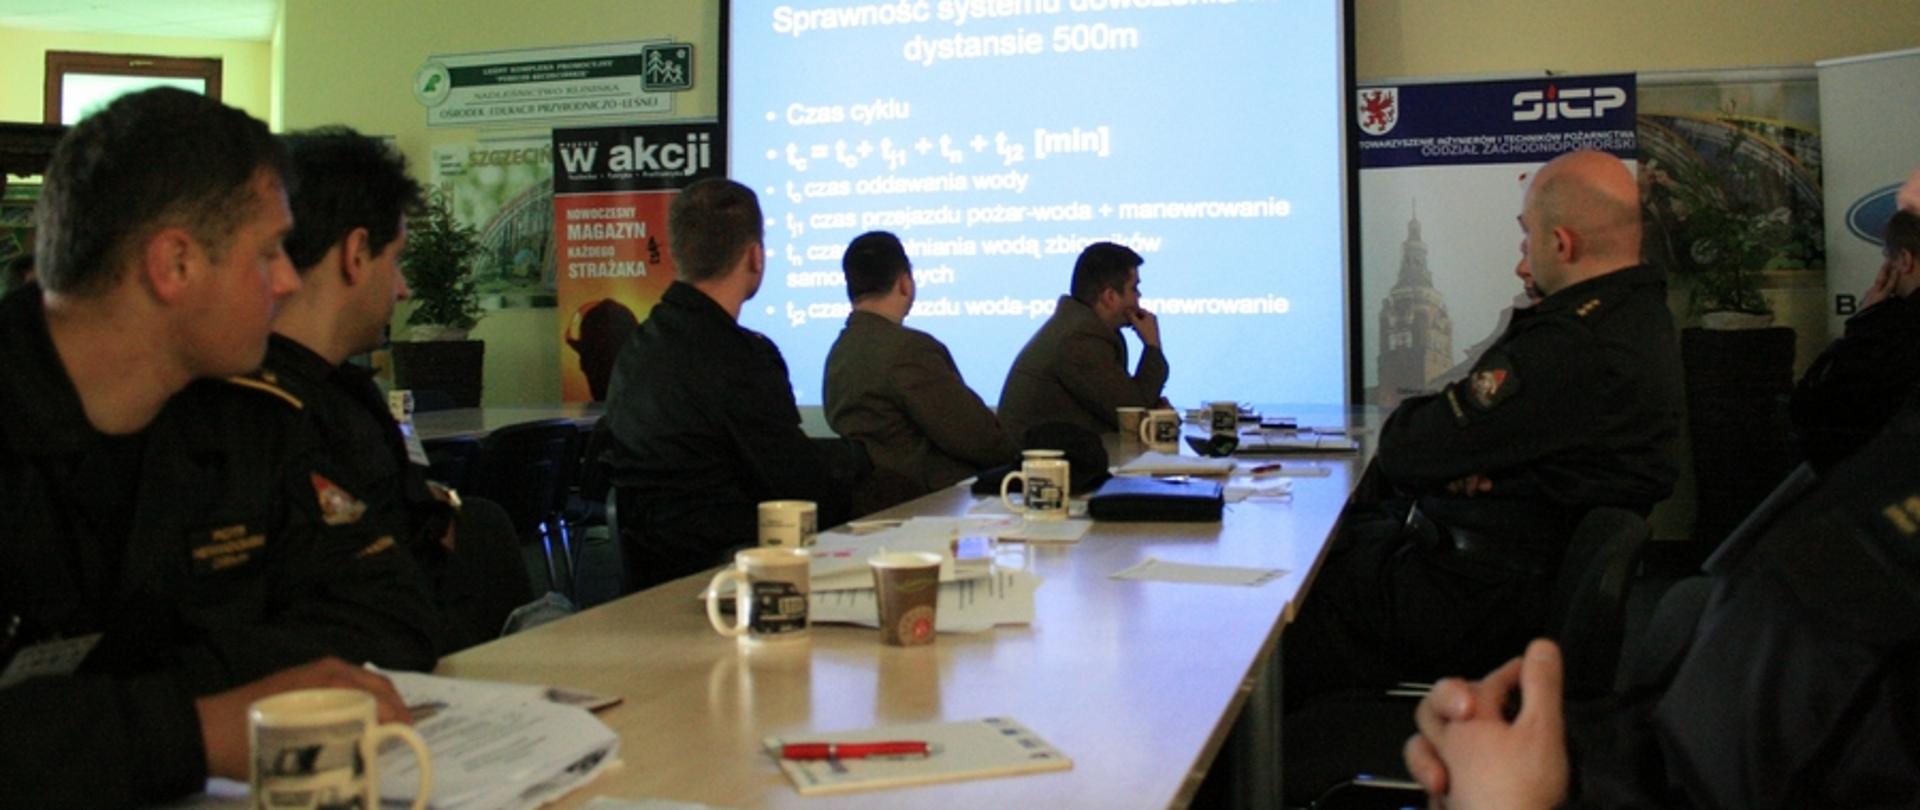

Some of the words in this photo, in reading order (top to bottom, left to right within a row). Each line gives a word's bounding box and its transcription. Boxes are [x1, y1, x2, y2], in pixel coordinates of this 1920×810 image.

[773, 1, 930, 37] Sprawność
[937, 0, 1061, 27] systemu
[904, 29, 1043, 66] dystansie
[1053, 23, 1138, 52] 500m
[787, 103, 844, 126] Czas
[851, 98, 910, 125] cyklu
[608, 133, 711, 176] akcji
[1034, 126, 1110, 160] [min]
[805, 181, 851, 197] czas
[856, 173, 967, 194] oddawania
[971, 170, 1029, 193] wody
[810, 212, 857, 228] czas
[862, 206, 960, 230] przejazdu
[967, 200, 1093, 225] pożar-woda
[1119, 197, 1290, 220] manewrowanie
[567, 222, 646, 241] MAGAZYN
[981, 233, 1041, 259] wodą
[568, 260, 647, 279] STRAŻAKA
